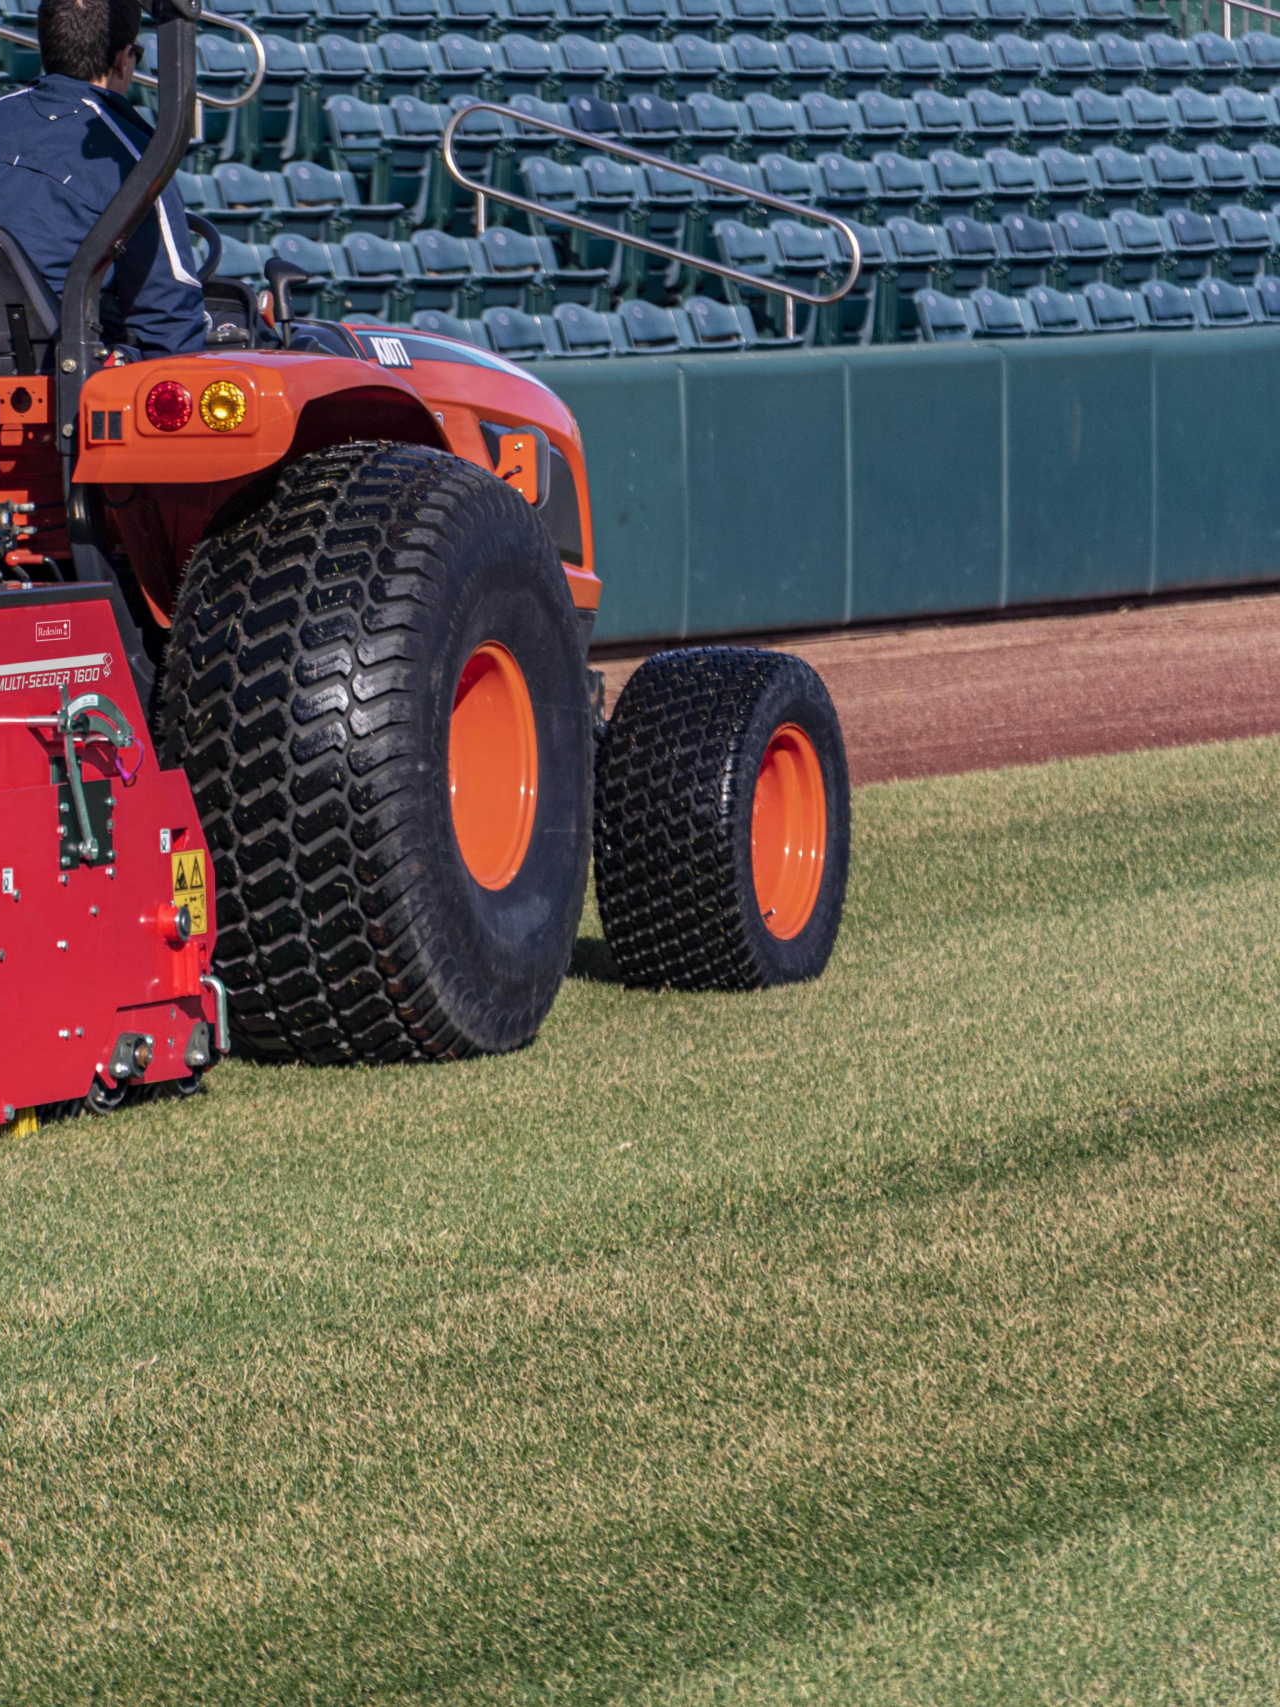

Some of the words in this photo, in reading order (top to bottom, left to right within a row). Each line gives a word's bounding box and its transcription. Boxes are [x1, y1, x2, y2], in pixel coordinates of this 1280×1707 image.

[369, 336, 412, 366] KIOTI
[38, 626, 63, 637] Redexim
[74, 667, 100, 683] 1600
